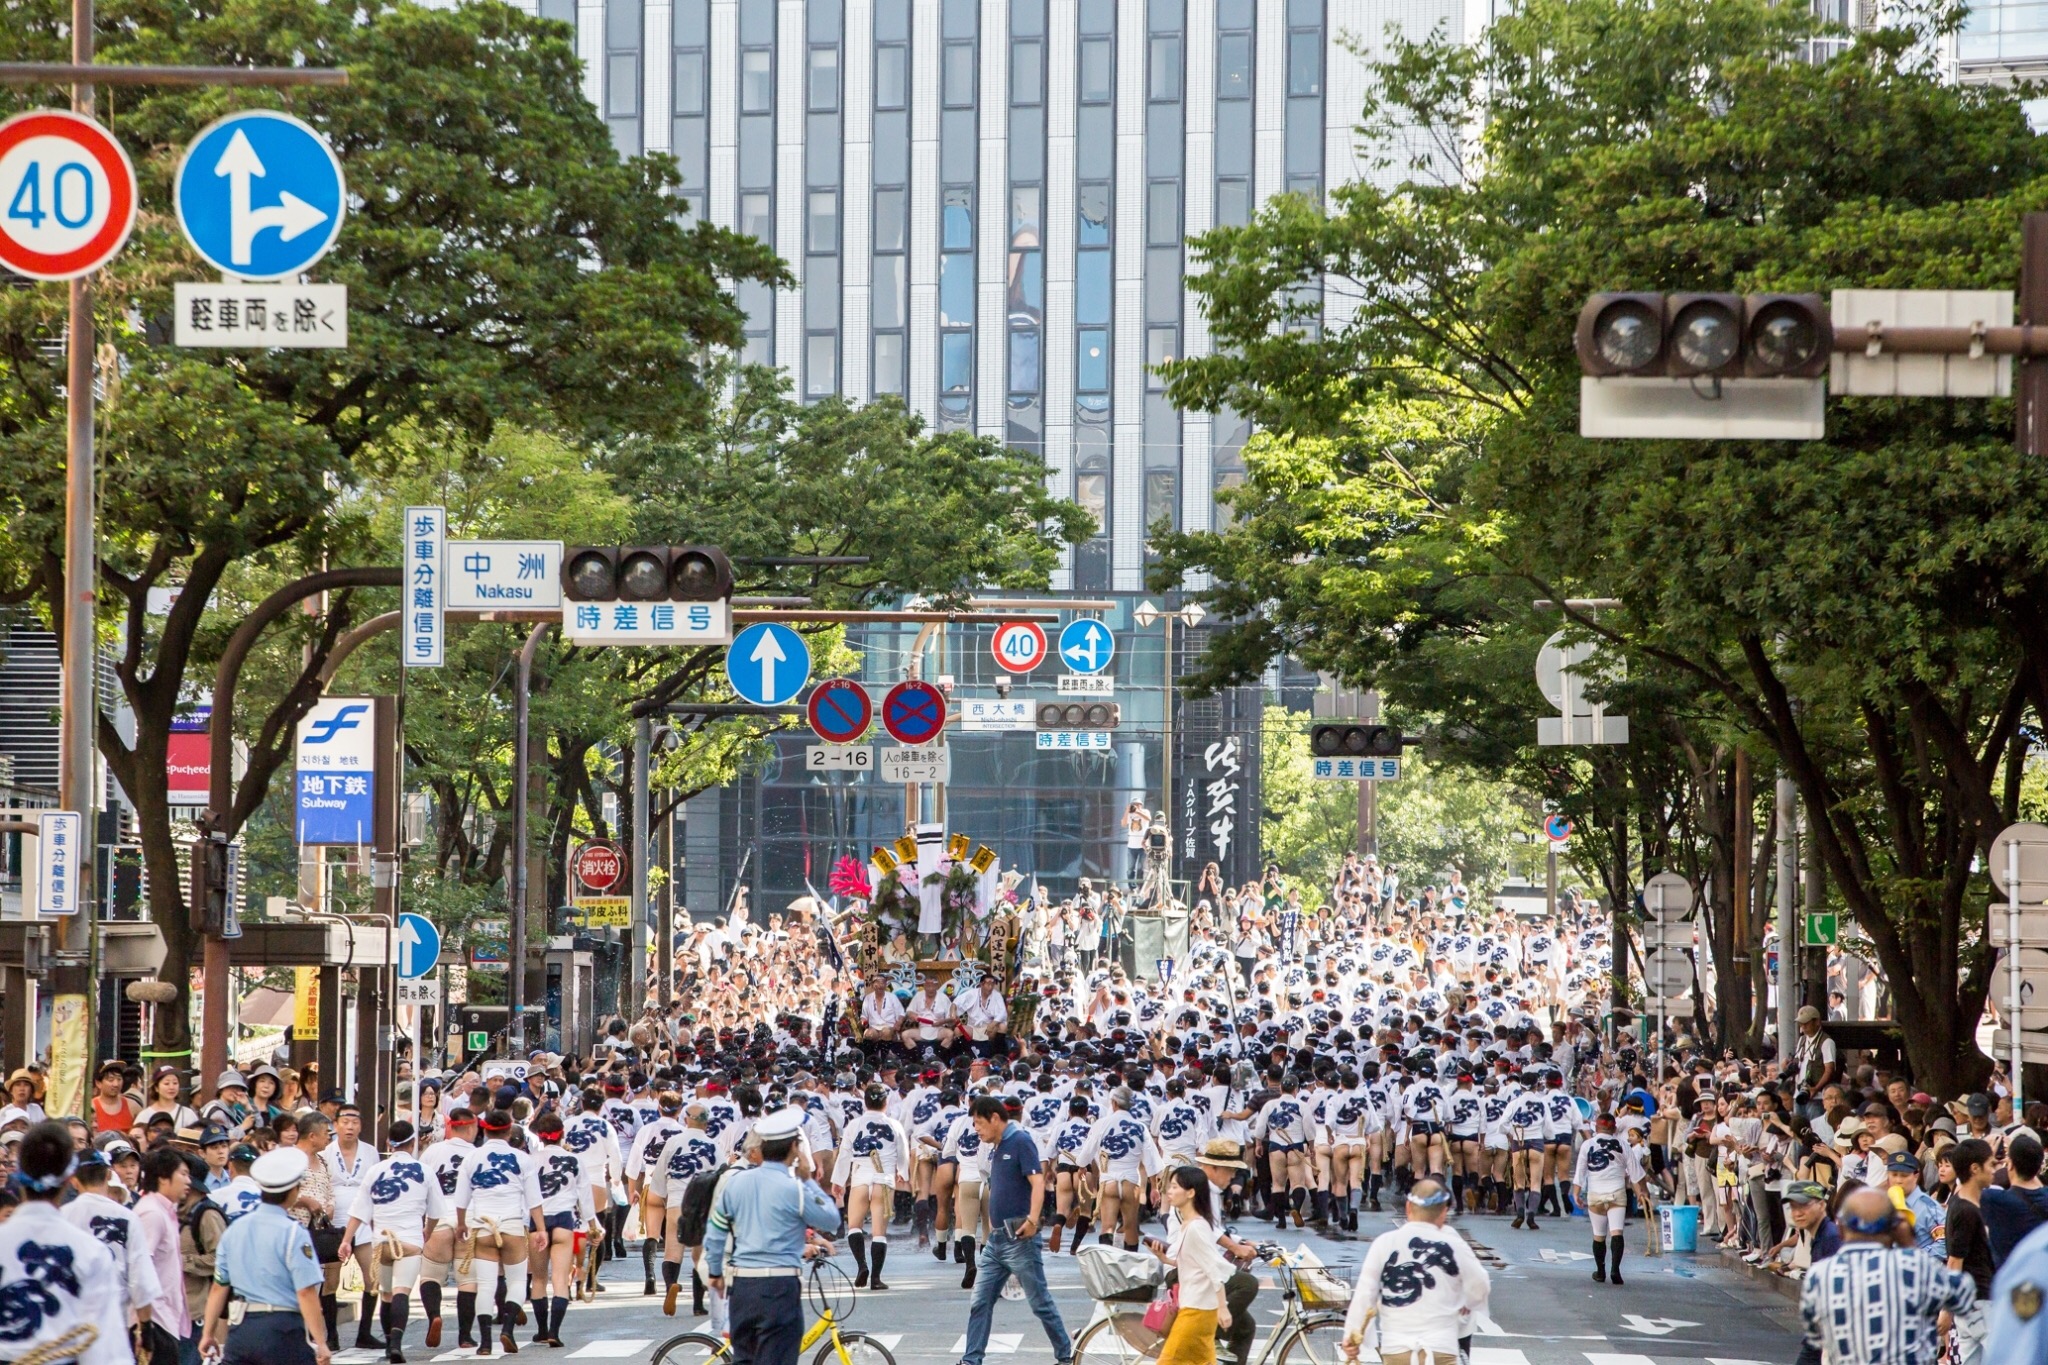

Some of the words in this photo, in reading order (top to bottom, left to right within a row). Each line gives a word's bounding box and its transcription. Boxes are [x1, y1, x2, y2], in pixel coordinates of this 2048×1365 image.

[8, 161, 94, 229] 40
[190, 298, 335, 333] 軽車両を除く
[463, 552, 545, 580] 中洲
[413, 515, 435, 658] 歩車分離信号
[475, 584, 533, 599] Nakasu
[577, 605, 712, 631] 時差信号
[1005, 634, 1034, 657] 40
[971, 703, 1026, 716] 西大橋
[1038, 733, 1110, 747] 時差信号
[301, 754, 331, 766] 지하철
[883, 750, 945, 764] 人の降車を除く
[1315, 760, 1398, 777] 時差信号
[301, 775, 368, 796] 地下鉄
[301, 797, 348, 810] Subway
[1185, 778, 1197, 859] JAグループ佐賀
[51, 817, 67, 910] 歩車分離信号
[581, 859, 616, 876] 消火栓
